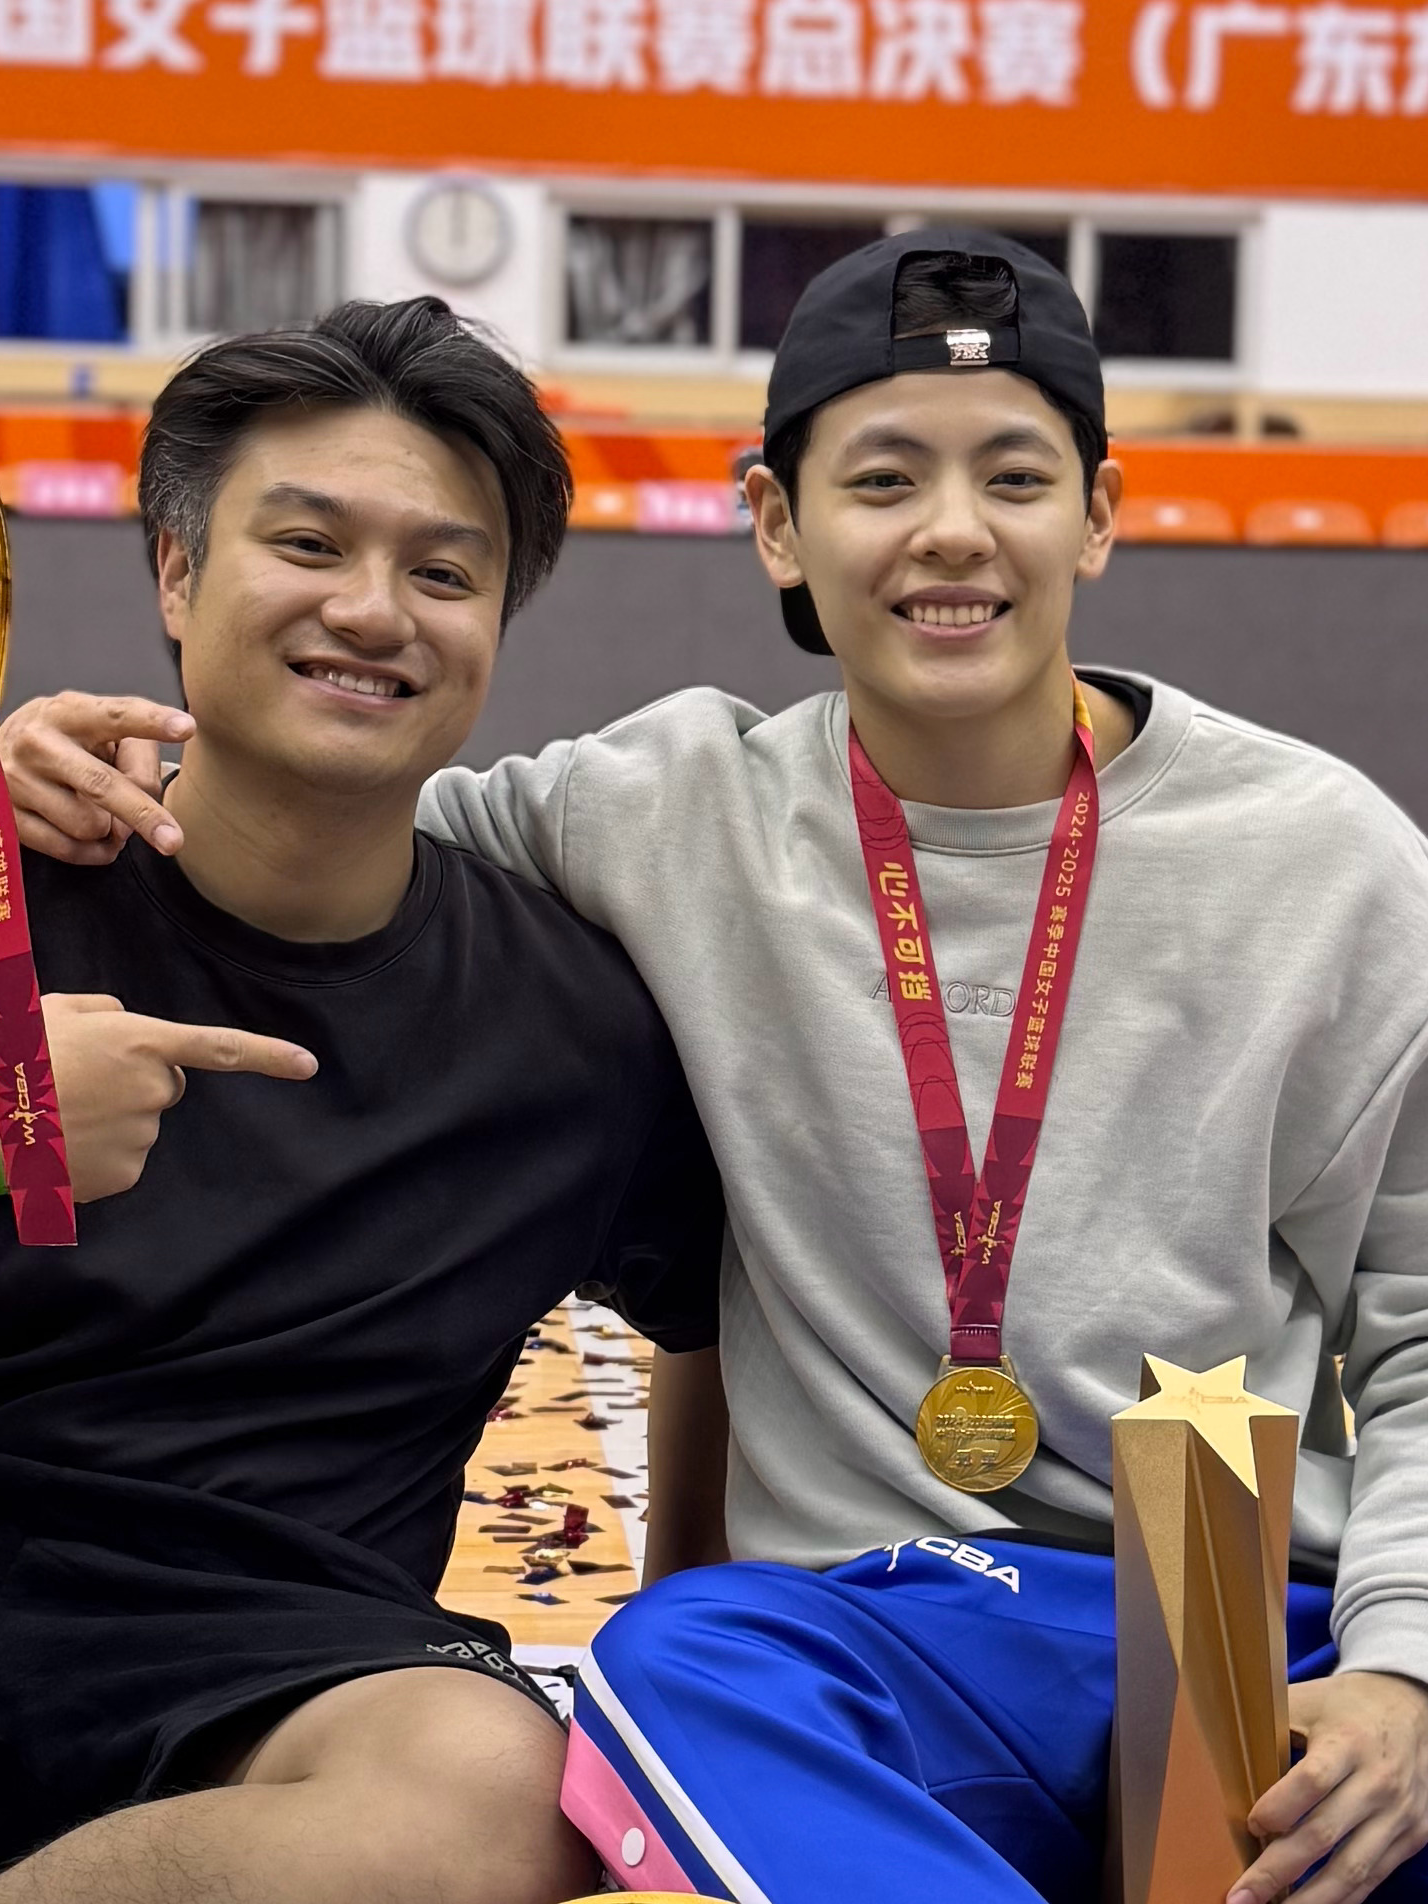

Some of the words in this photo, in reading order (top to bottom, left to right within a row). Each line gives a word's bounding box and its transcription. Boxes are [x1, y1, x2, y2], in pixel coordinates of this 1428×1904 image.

[1055, 791, 1091, 898] 2024-2025
[878, 860, 933, 1001] 心不可挡
[1014, 903, 1070, 1090] 赛季中国女子篮球联赛
[915, 1536, 1020, 1594] CBA
